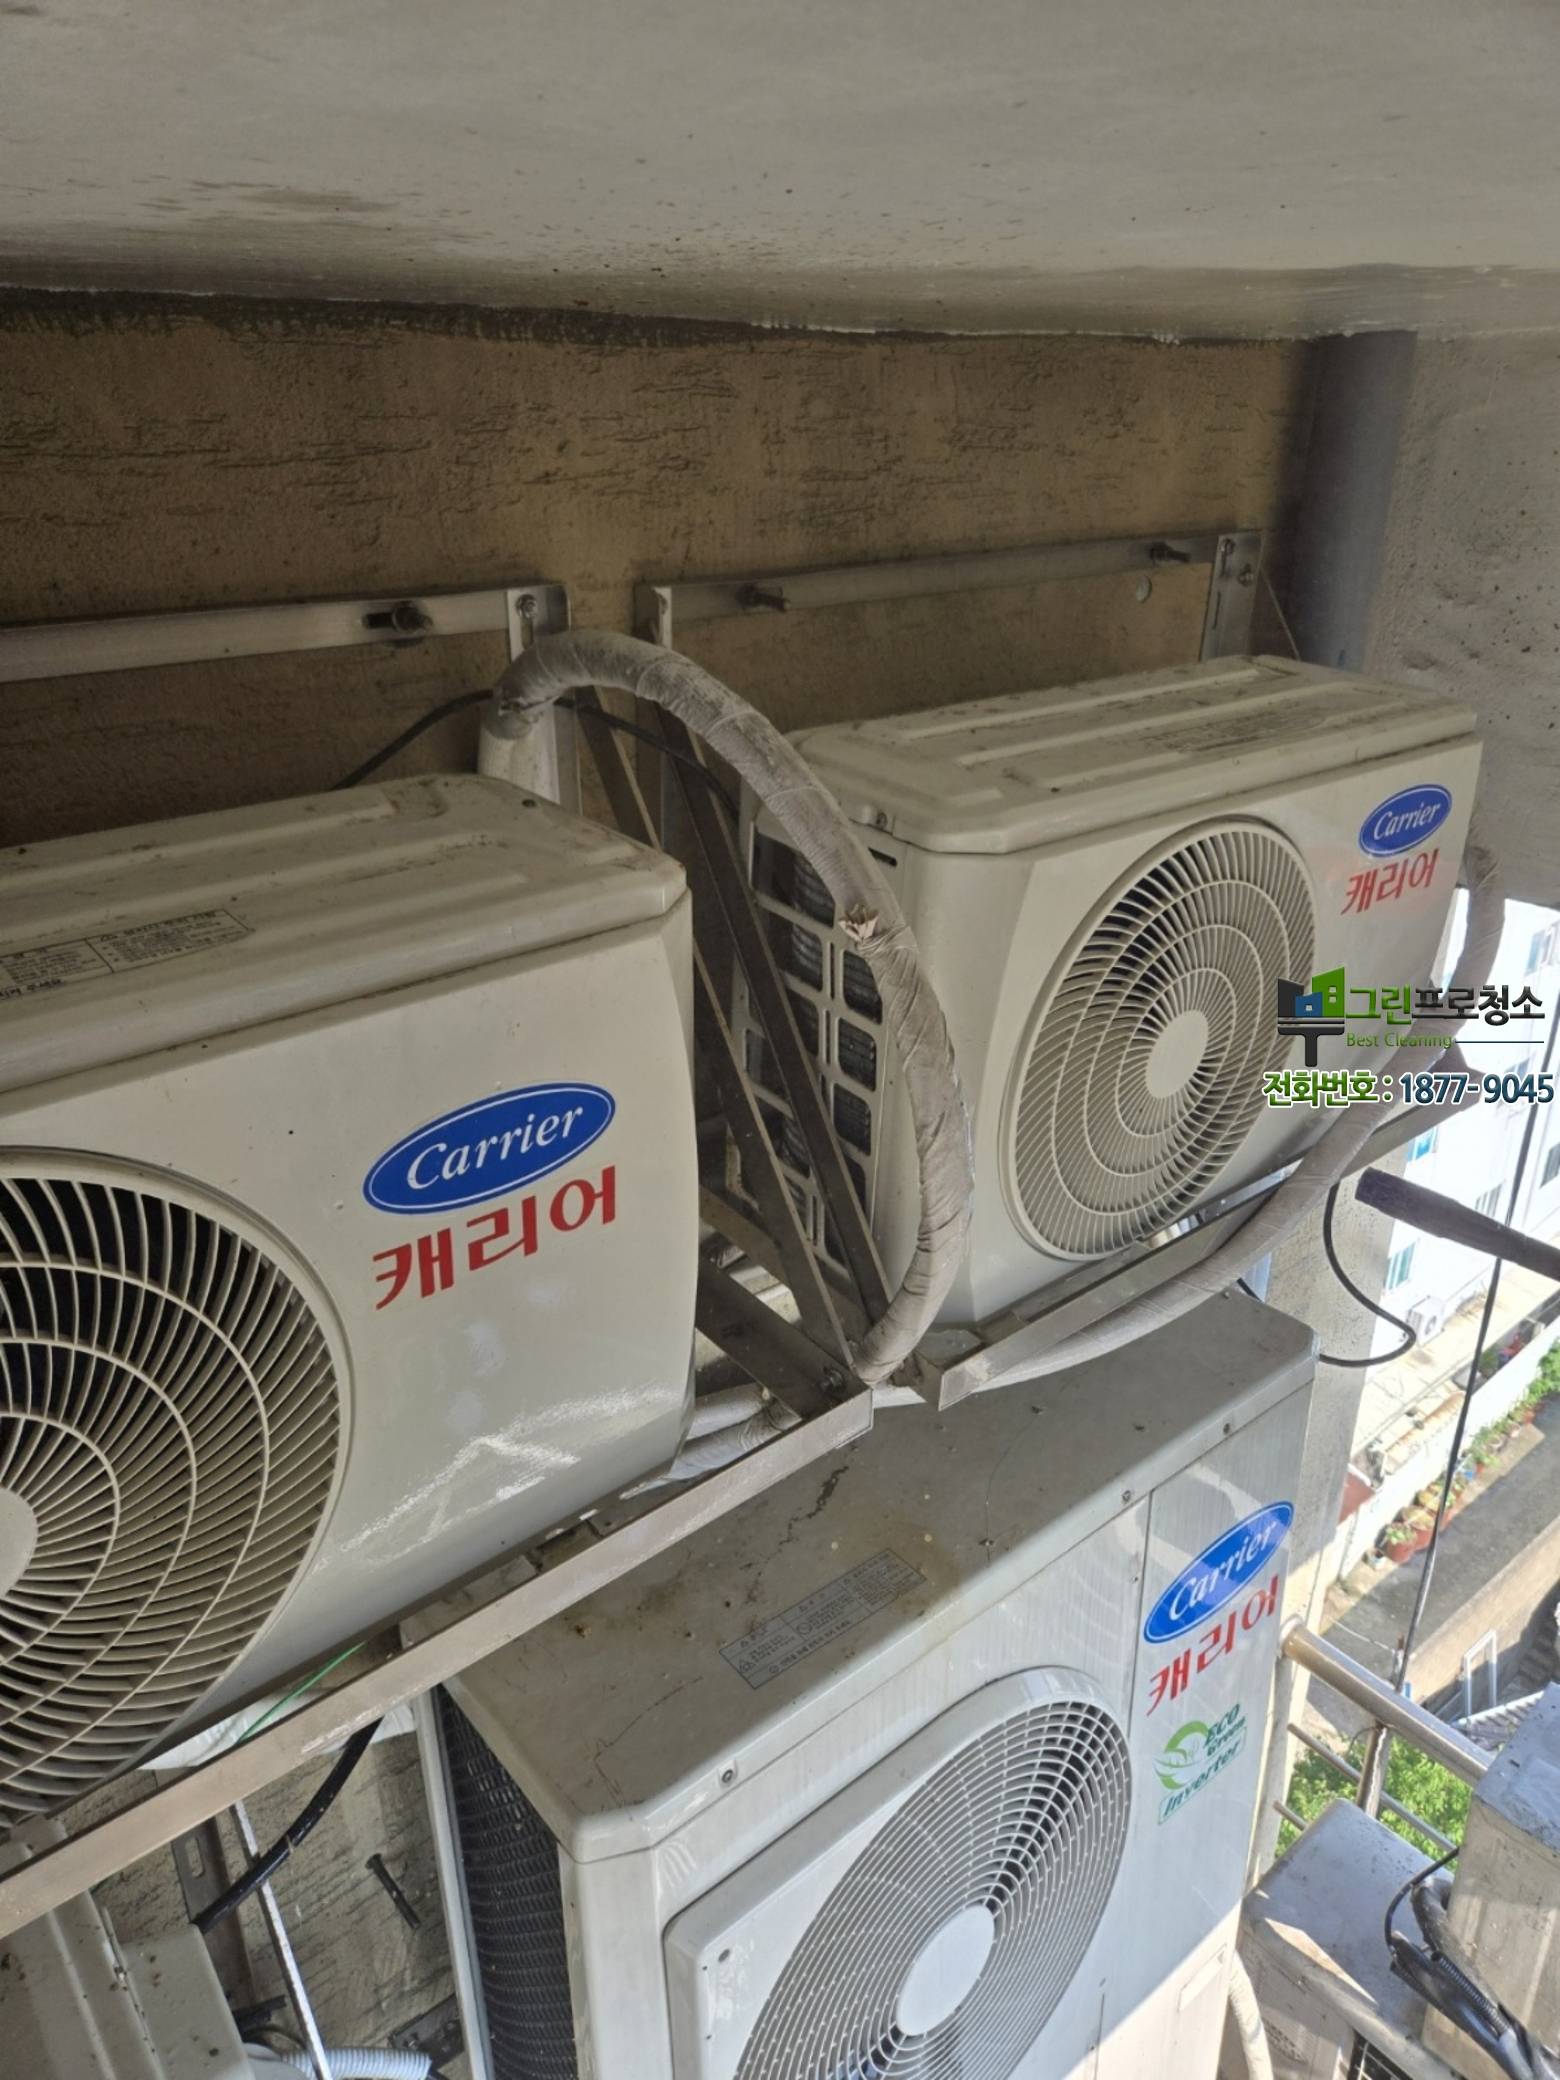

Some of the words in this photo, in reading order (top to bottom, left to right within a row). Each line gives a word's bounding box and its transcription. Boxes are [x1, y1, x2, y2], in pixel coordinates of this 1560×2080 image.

[1373, 801, 1441, 840] Carrier
[1341, 848, 1439, 915] 캐리어
[407, 1106, 584, 1190] Carrier
[372, 1164, 616, 1311] 캐리어
[1168, 1520, 1277, 1621] Carrier
[1146, 1574, 1279, 1717] 캐리어
[1163, 1739, 1240, 1817] Inverter
